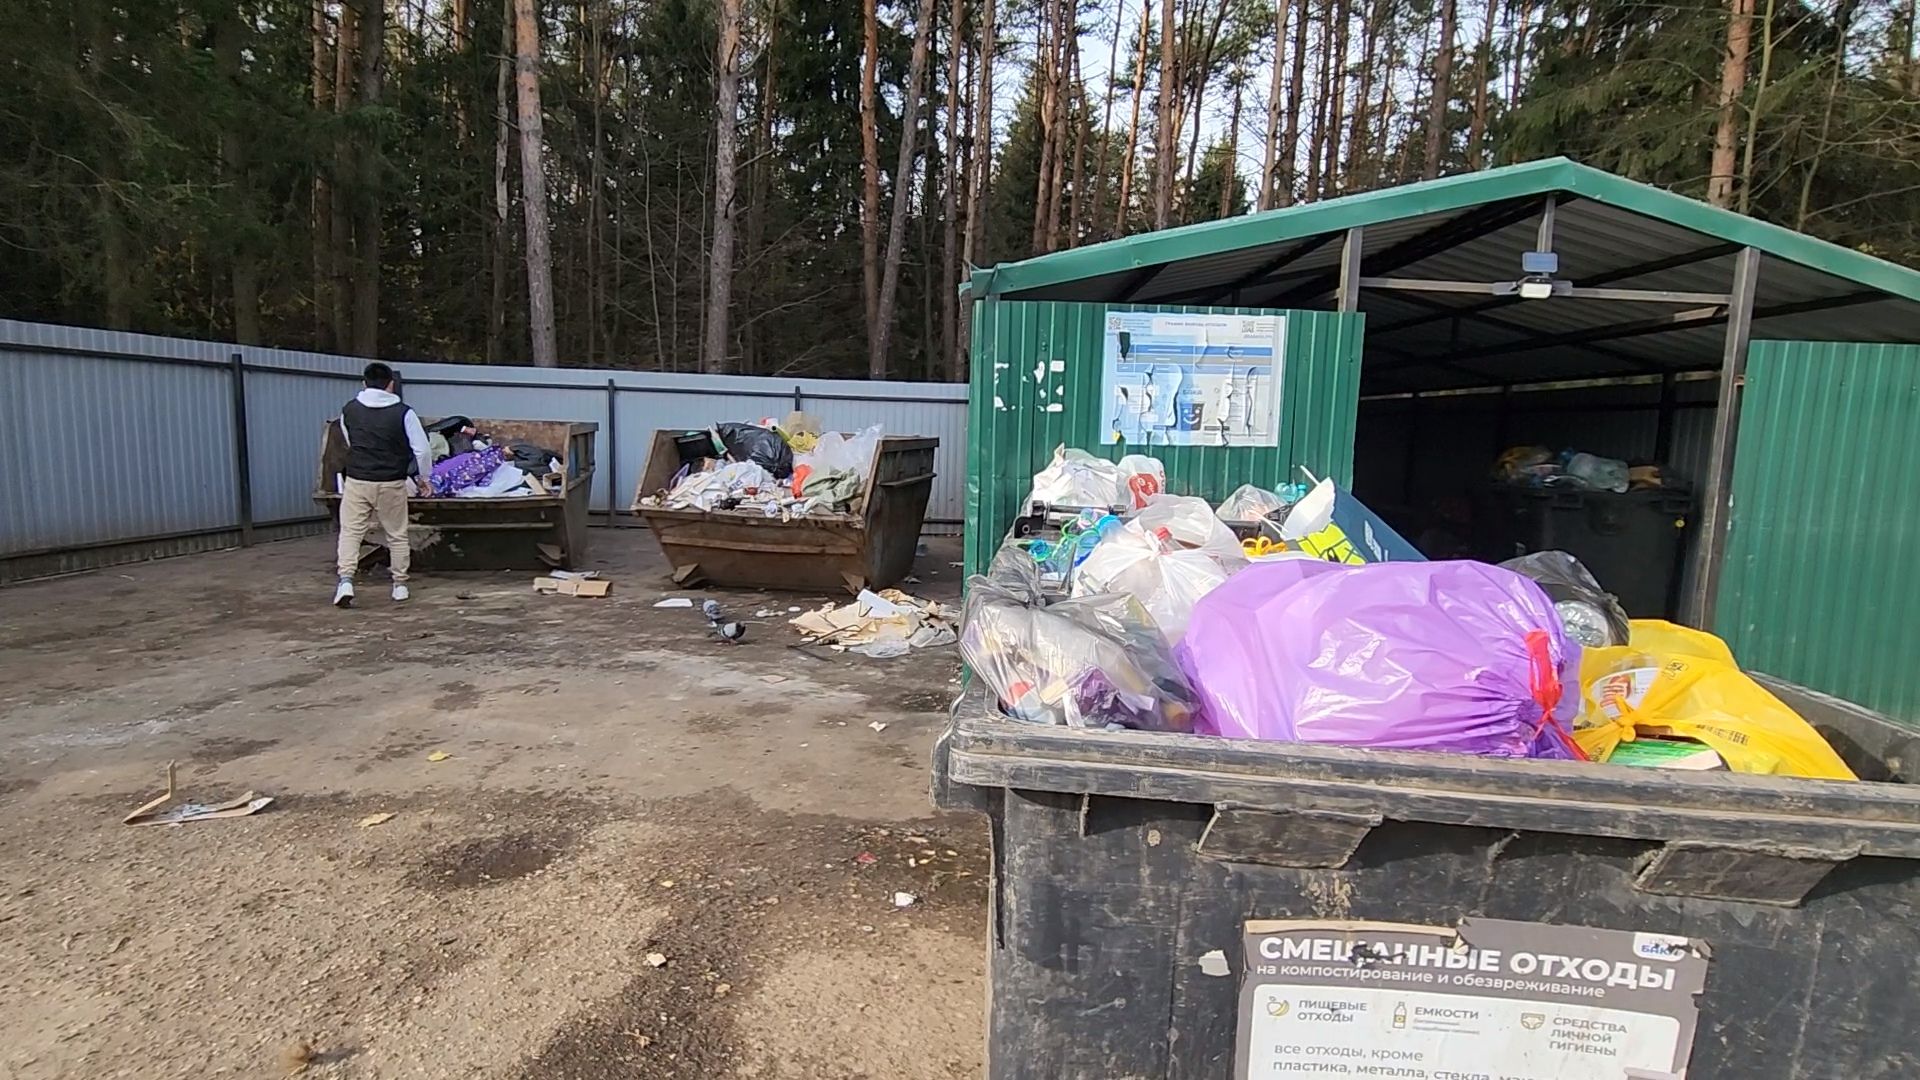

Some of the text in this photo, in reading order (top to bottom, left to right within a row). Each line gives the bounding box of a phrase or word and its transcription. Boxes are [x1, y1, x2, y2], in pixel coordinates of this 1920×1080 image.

[1509, 952, 1676, 991] ОТХОДЫ
[1257, 965, 1606, 998] на компостирование и обезвреживание
[1298, 999, 1367, 1012] ПИЩЕВЫЕ
[1414, 1006, 1479, 1020] ЕМКОСТИ
[1297, 1011, 1354, 1023] ОТХОДЫ
[1552, 1017, 1628, 1033] СРЕДСТВА
[1551, 1029, 1612, 1044] ЛИЧНОЙ
[1274, 1044, 1424, 1062] все отходы, кроме
[1549, 1041, 1617, 1057] ГИГИЕНЫ
[1273, 1061, 1352, 1075] пластика,
[1356, 1064, 1428, 1080] металла,
